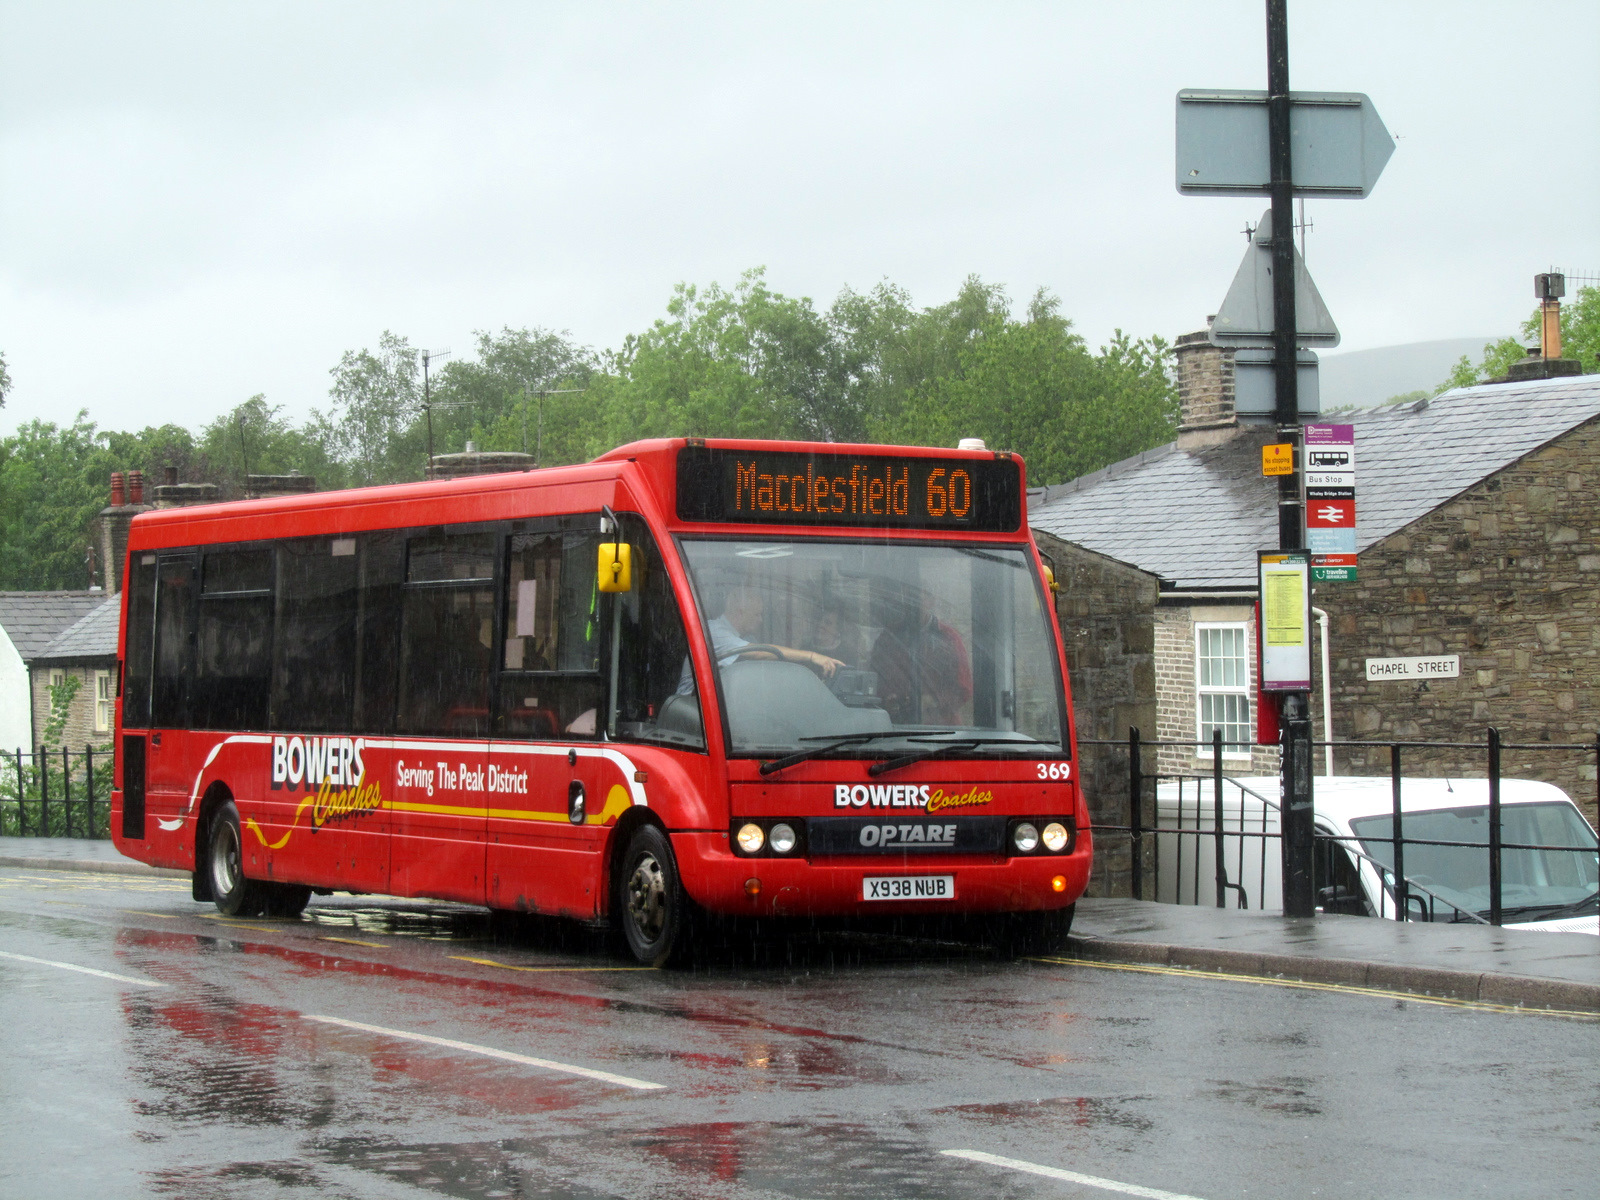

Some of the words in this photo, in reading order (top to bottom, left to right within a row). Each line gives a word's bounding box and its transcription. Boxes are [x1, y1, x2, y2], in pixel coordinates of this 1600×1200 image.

[1272, 457, 1290, 465] stopping
[736, 460, 908, 515] Macclesfield
[926, 467, 971, 517] 60
[1309, 475, 1323, 483] Bus
[1325, 475, 1343, 484] Stop
[1370, 663, 1409, 675] CHAPEL
[1417, 661, 1455, 673] STREET
[272, 736, 366, 788] BOWERS
[1037, 762, 1070, 780] 369
[397, 759, 434, 797] Serving
[437, 761, 457, 790] The
[459, 763, 485, 792] Peak
[488, 764, 528, 794] District
[314, 770, 382, 828] Coaches
[835, 784, 930, 808] BOWERS
[926, 786, 994, 813] Coaches
[859, 824, 957, 848] OPTARE
[870, 880, 911, 898] X938
[915, 879, 946, 896] NUB
